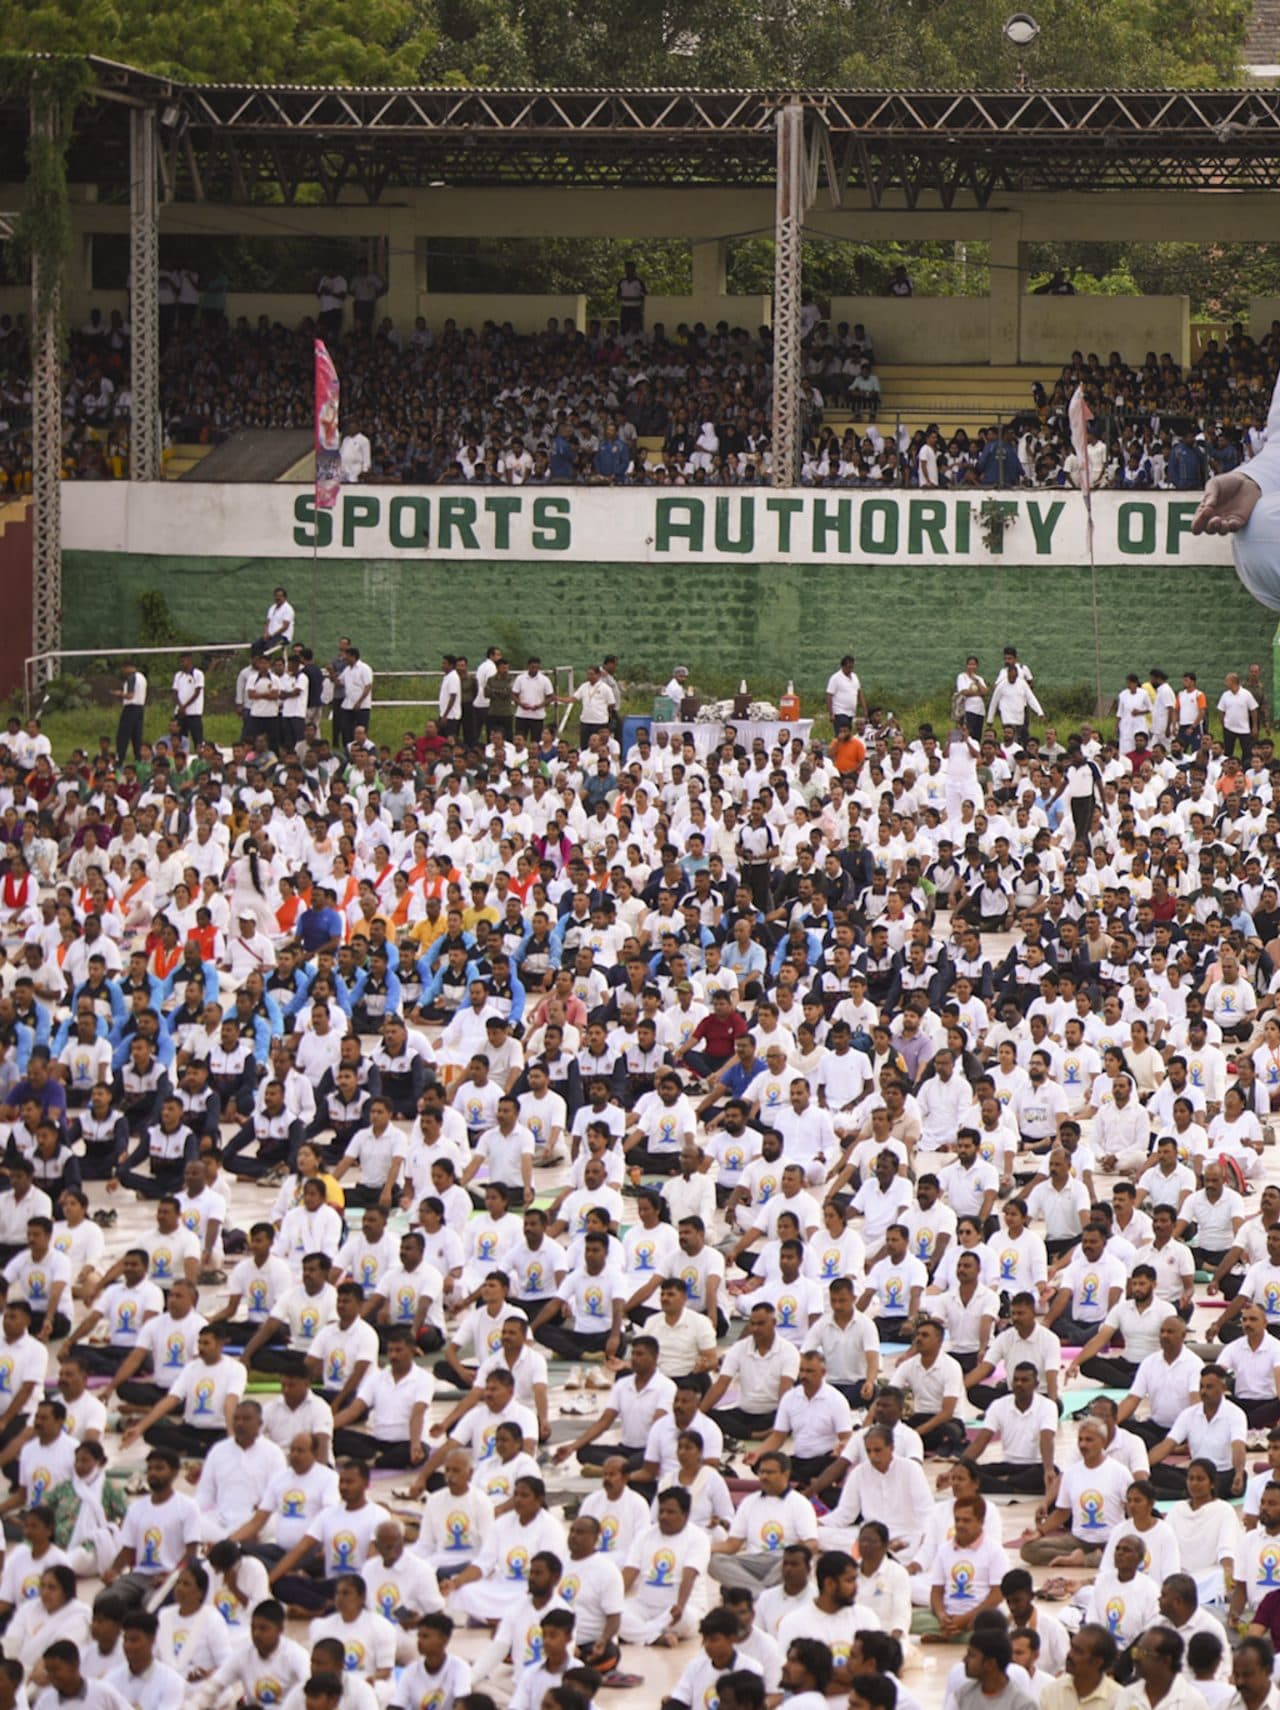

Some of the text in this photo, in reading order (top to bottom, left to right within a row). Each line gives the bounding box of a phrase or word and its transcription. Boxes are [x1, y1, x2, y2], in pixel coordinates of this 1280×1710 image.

[293, 495, 1195, 555] SPORTS AUTHORITY OF
